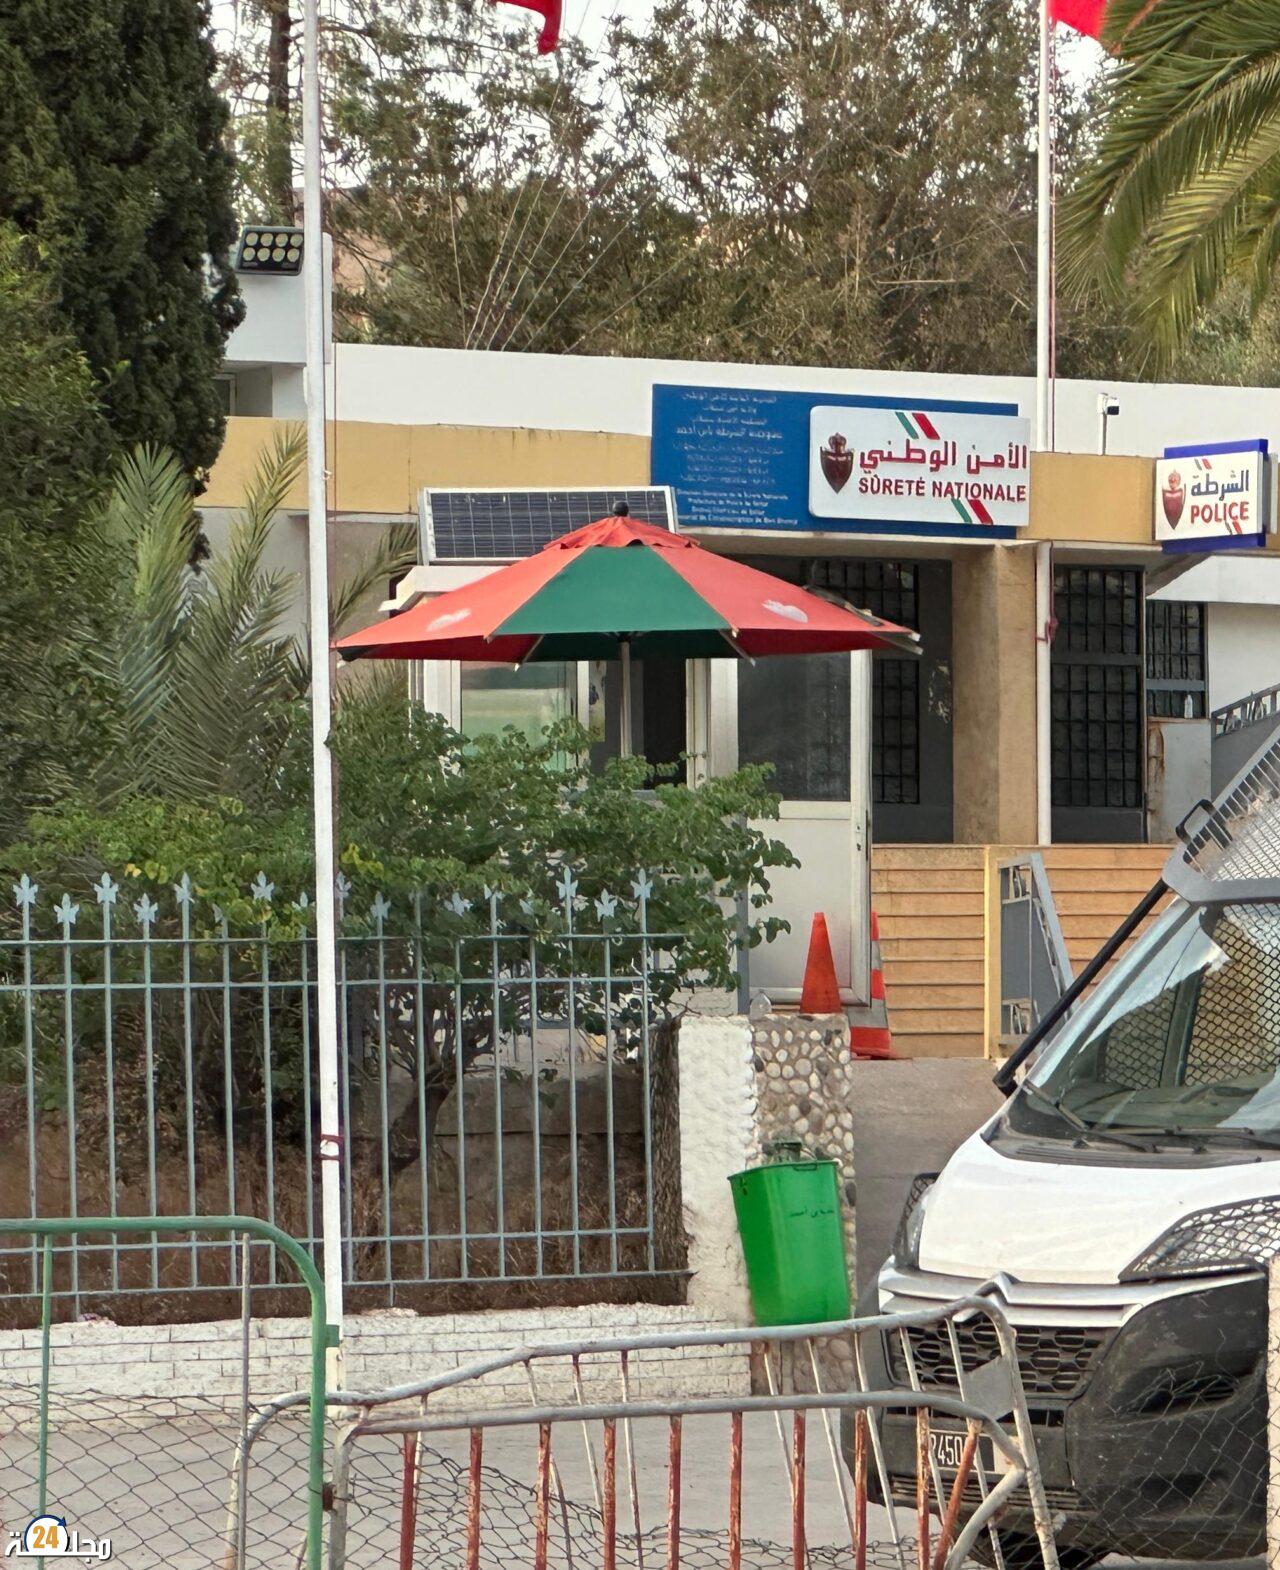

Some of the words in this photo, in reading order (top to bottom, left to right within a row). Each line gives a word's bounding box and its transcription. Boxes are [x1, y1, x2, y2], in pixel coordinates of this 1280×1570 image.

[859, 438, 957, 474] الوطني
[966, 442, 1027, 475] الأمن
[858, 475, 926, 497] SÛRETÉ
[931, 480, 1027, 502] NATIONALE
[1190, 469, 1250, 501] الشرطة
[1190, 501, 1250, 524] POLICE
